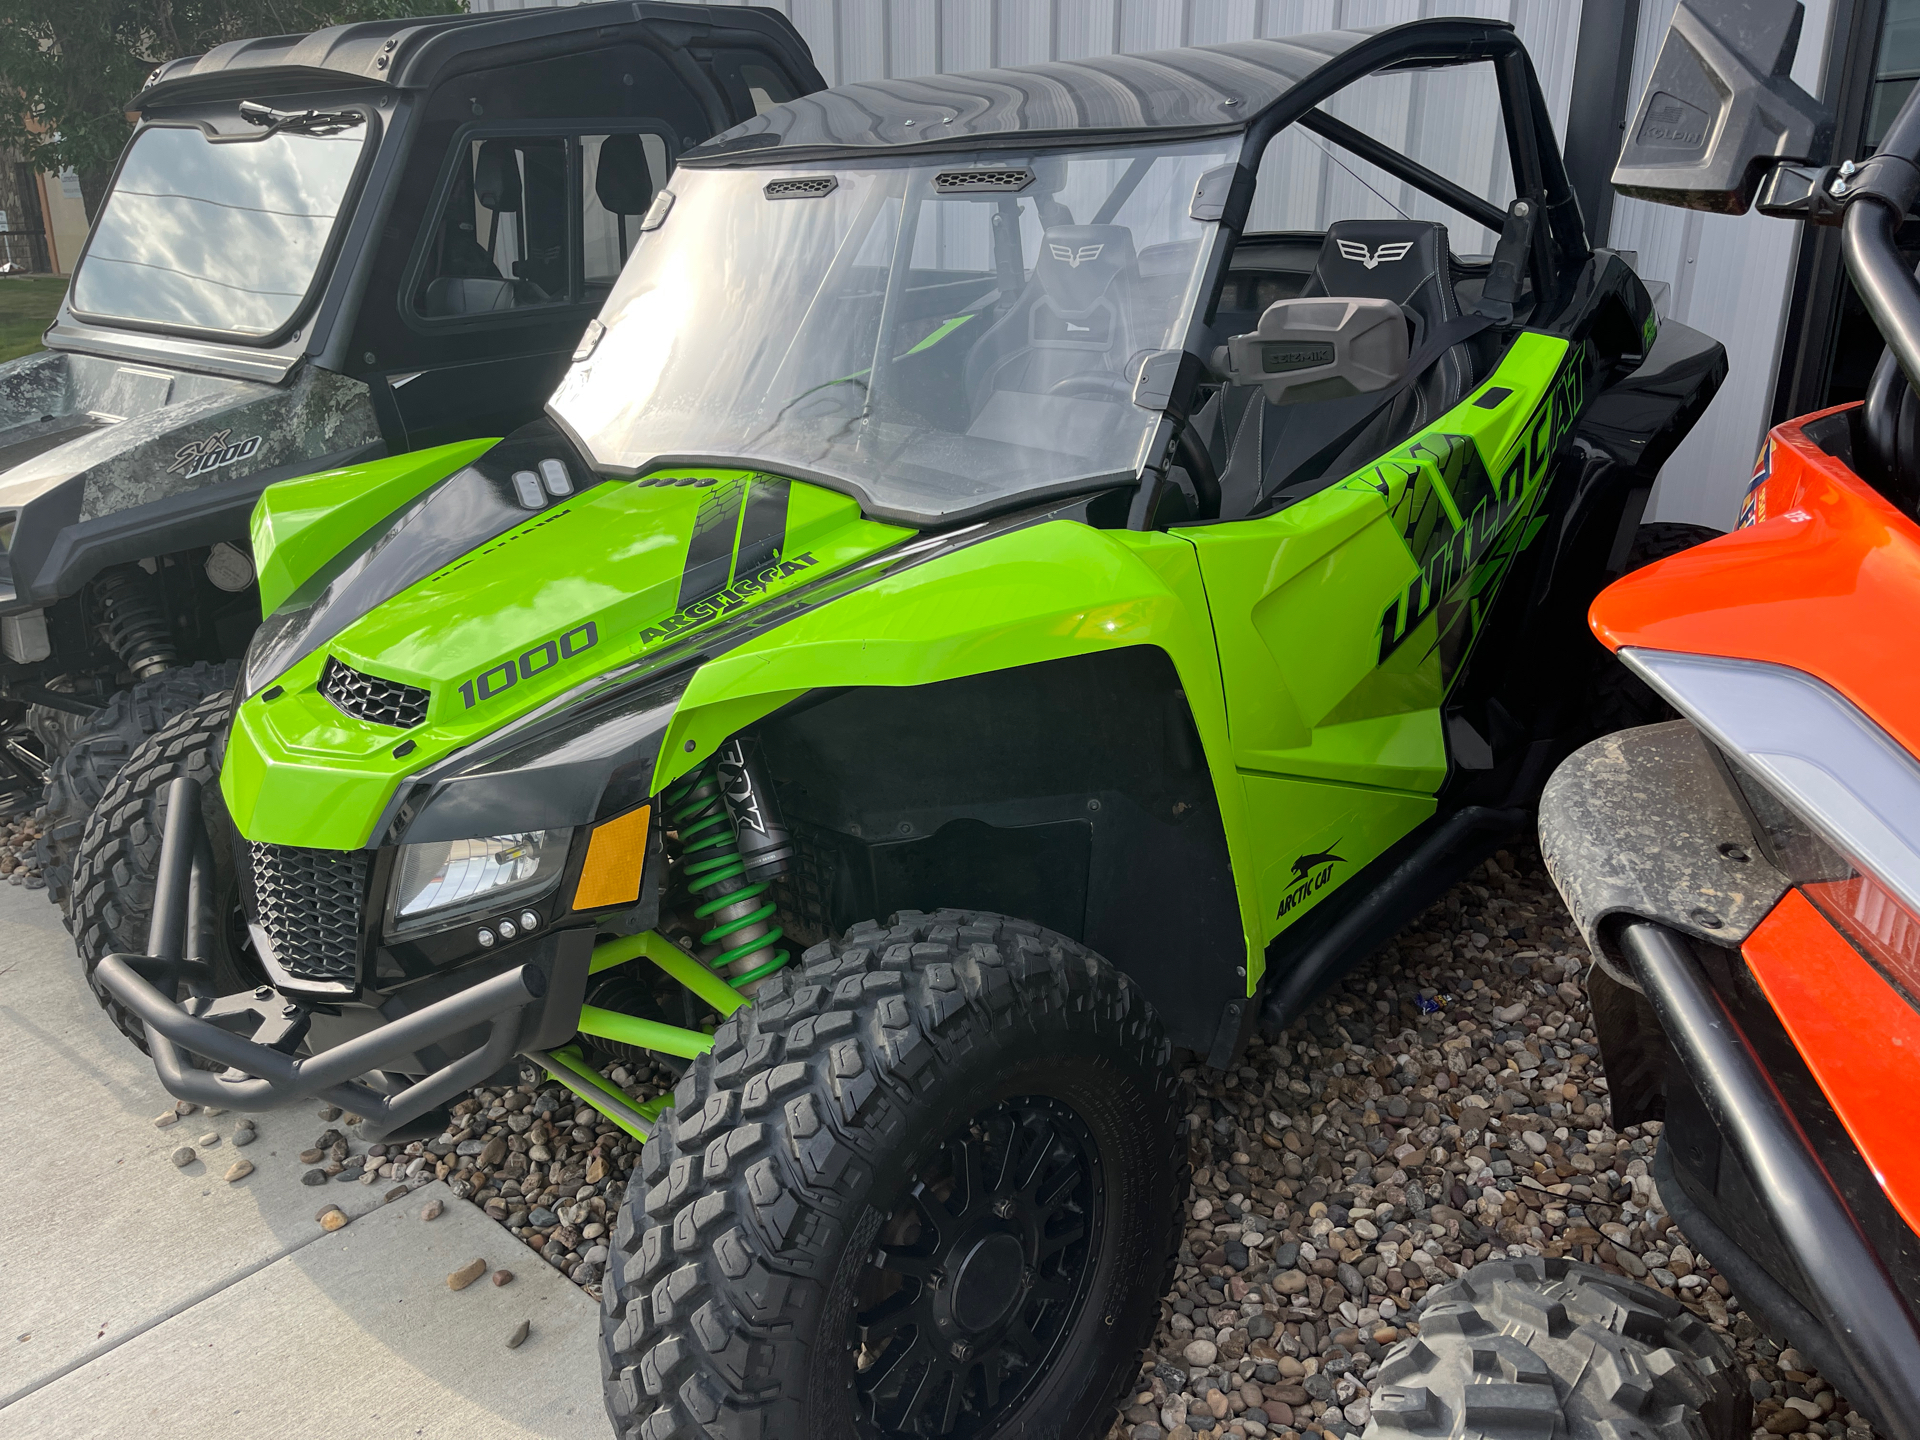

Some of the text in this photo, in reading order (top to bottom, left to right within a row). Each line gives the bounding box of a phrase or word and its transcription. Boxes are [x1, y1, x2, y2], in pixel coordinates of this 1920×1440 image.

[1644, 127, 1701, 144] KOLPIN
[1270, 350, 1329, 364] SEIZMIK
[185, 435, 262, 479] 1000
[638, 550, 820, 645] ARCTIC CAT
[457, 621, 598, 709] 1000
[1276, 863, 1334, 920] ARCTIC CAT
